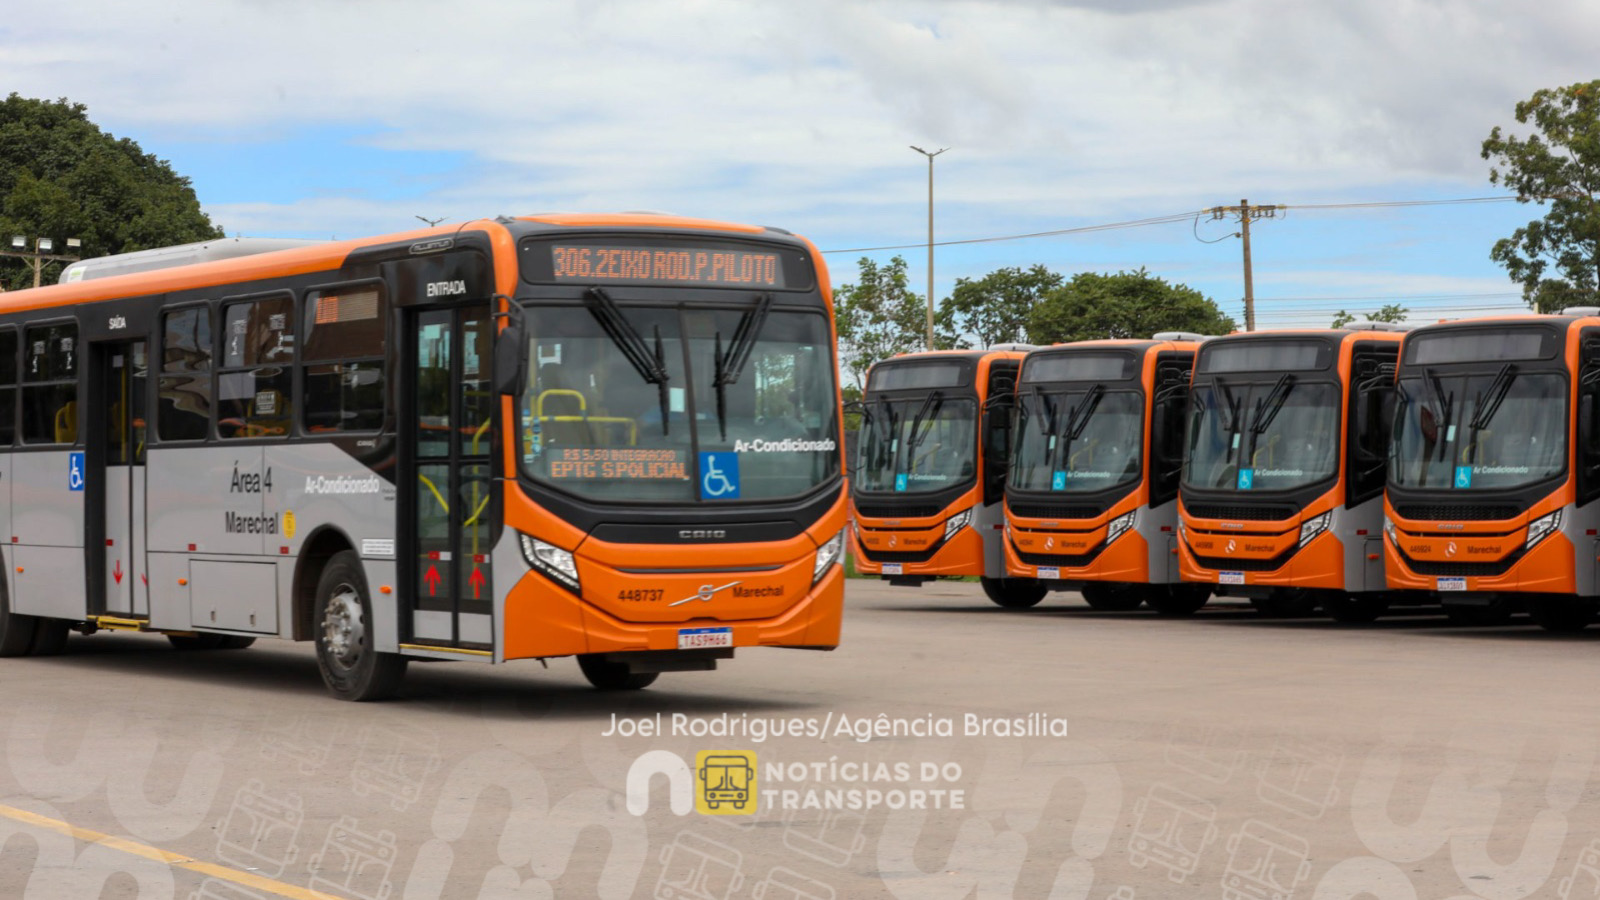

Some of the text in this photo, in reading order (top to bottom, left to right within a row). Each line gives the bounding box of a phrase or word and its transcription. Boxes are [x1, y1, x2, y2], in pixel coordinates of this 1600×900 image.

[427, 280, 466, 297] ENTRADA
[734, 438, 836, 453] Ar-Condicionado
[230, 460, 272, 493] Área 4
[551, 461, 596, 478] EPTG
[1482, 465, 1528, 474] Condicionado
[305, 475, 380, 494] Ar-Condicionado
[225, 511, 279, 534] Marechal
[678, 529, 726, 539] CAIO
[1467, 545, 1502, 554] Marechal
[618, 589, 665, 602] 448737
[732, 585, 784, 598] Marechal
